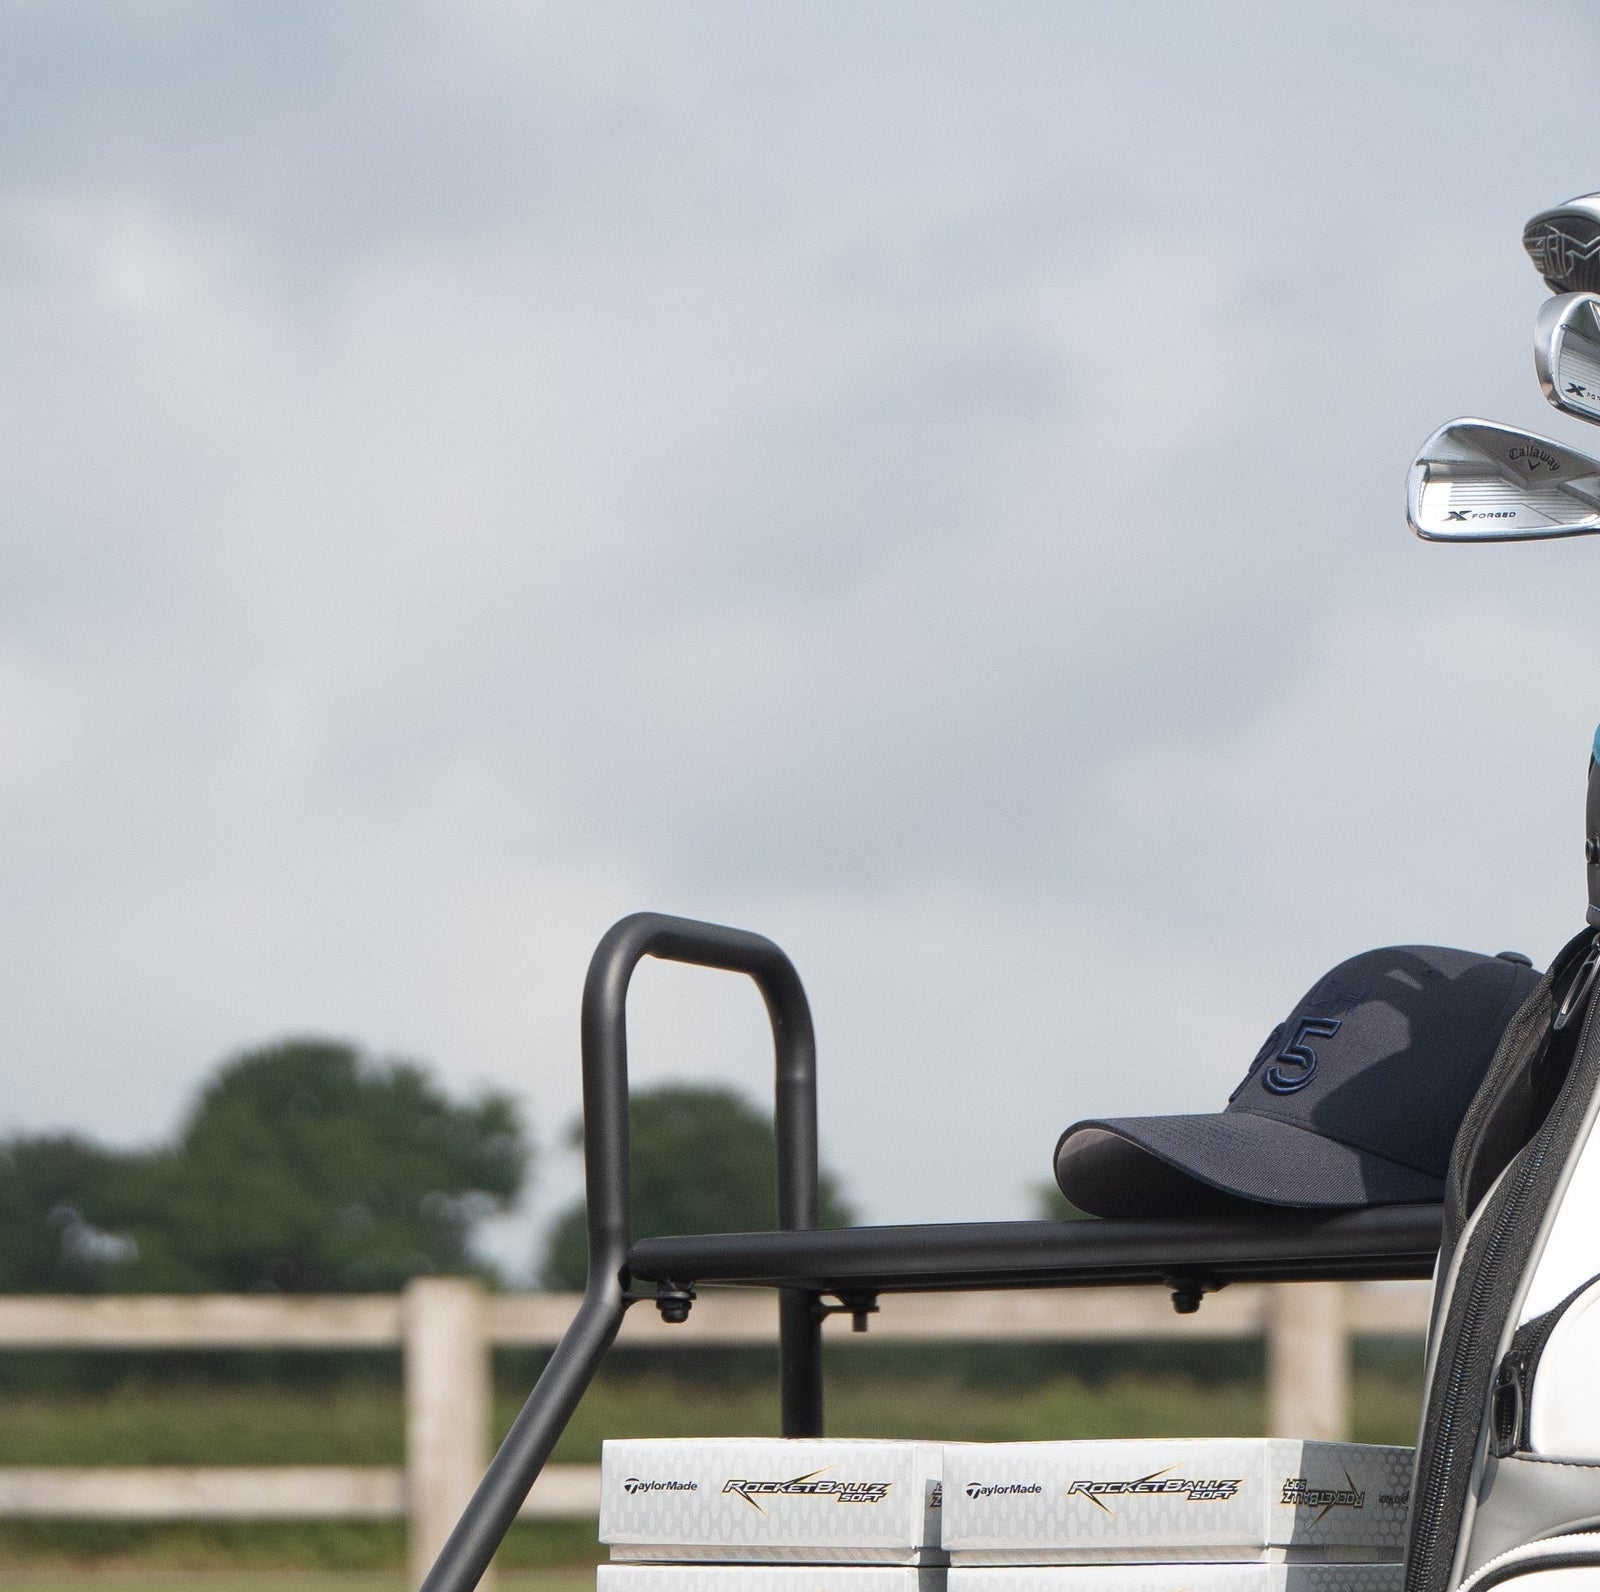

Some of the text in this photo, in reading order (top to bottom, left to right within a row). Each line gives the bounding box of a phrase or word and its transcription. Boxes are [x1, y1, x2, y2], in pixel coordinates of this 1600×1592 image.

[1509, 445, 1560, 471] Callaway
[1472, 511, 1516, 519] FORGED
[624, 1478, 698, 1494] TaylorMade
[965, 1482, 1042, 1499] TaylorMade
[837, 1492, 887, 1502] SOFT
[1187, 1490, 1236, 1501] SOFT
